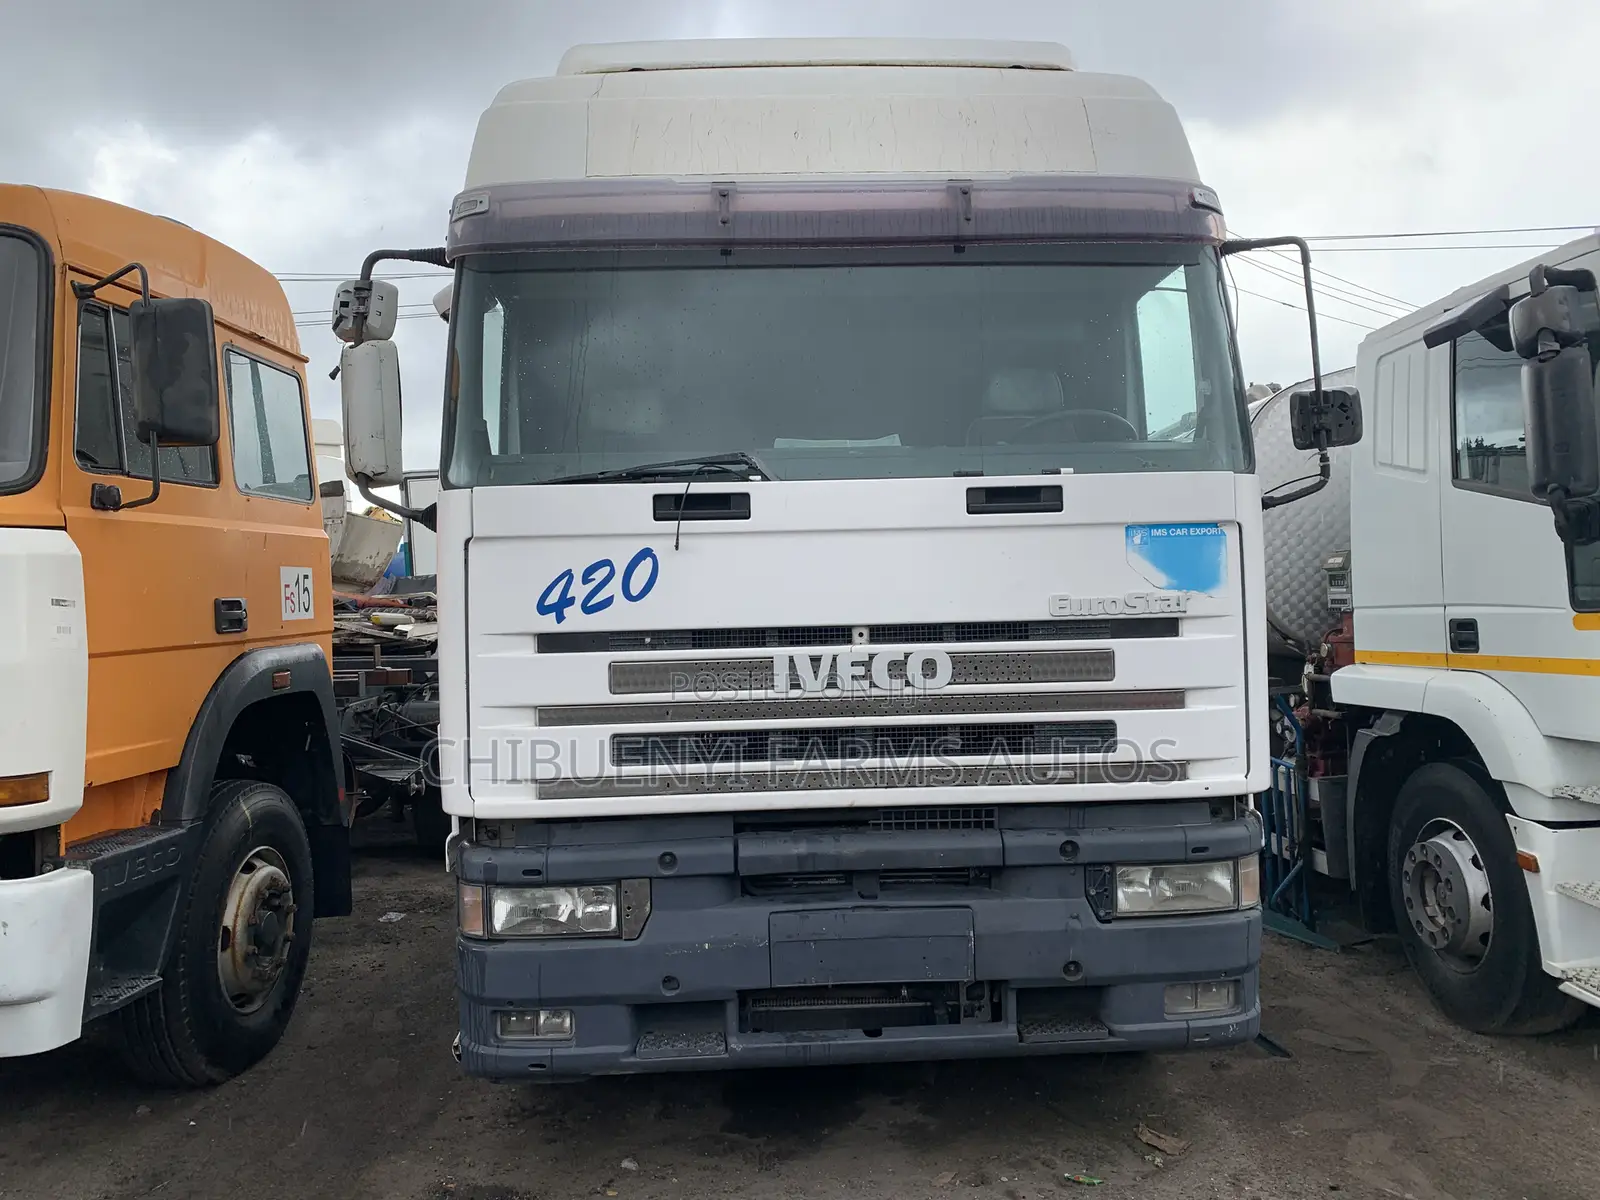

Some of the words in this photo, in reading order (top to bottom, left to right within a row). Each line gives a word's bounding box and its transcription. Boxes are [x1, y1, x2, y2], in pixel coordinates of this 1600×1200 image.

[1151, 528, 1168, 537] IMS
[1170, 528, 1188, 536] CAR
[1189, 527, 1222, 536] EXPORT
[536, 547, 659, 624] 420
[1049, 591, 1192, 617] EuroStar
[772, 650, 953, 693] IVECO
